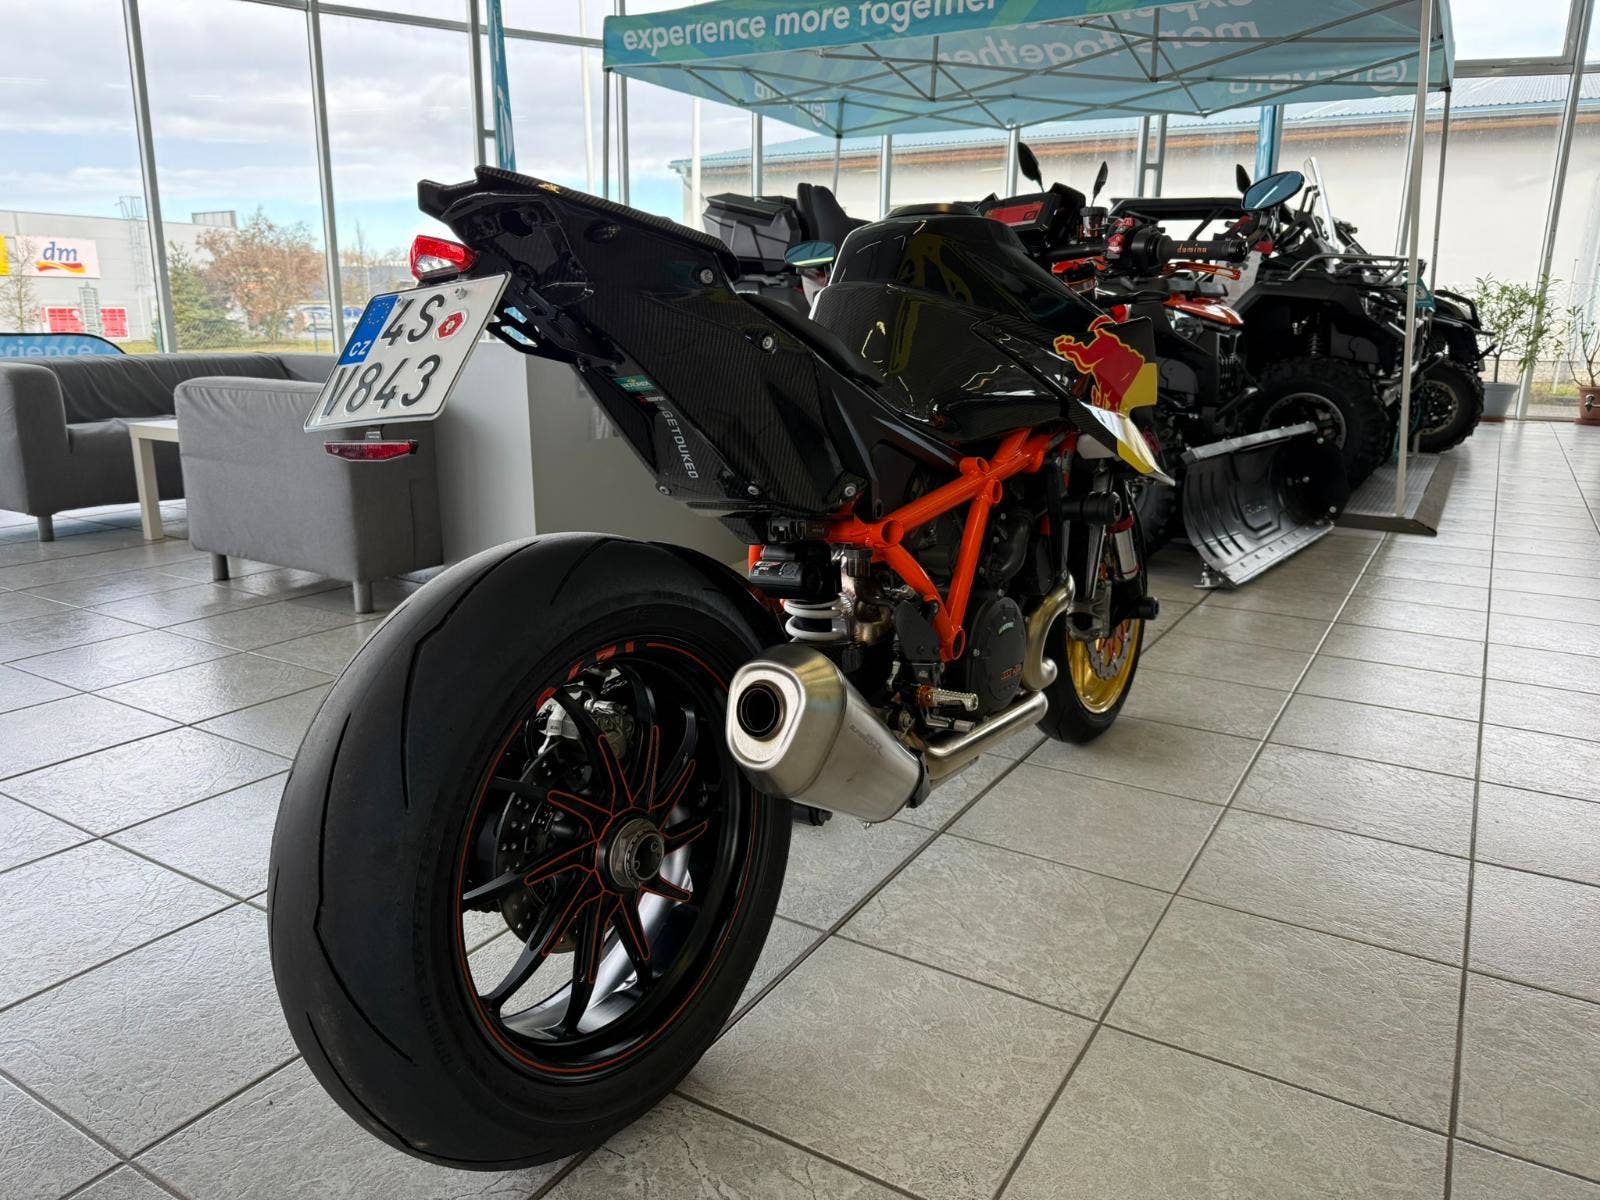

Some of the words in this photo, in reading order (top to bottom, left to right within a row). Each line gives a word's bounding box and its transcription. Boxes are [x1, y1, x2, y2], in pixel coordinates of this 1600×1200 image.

[623, 15, 767, 56] experience
[773, 7, 851, 36] more
[43, 241, 77, 262] dm
[381, 294, 445, 346] 4S
[0, 340, 94, 357] rience
[349, 340, 371, 357] CZ
[321, 354, 441, 417] V843
